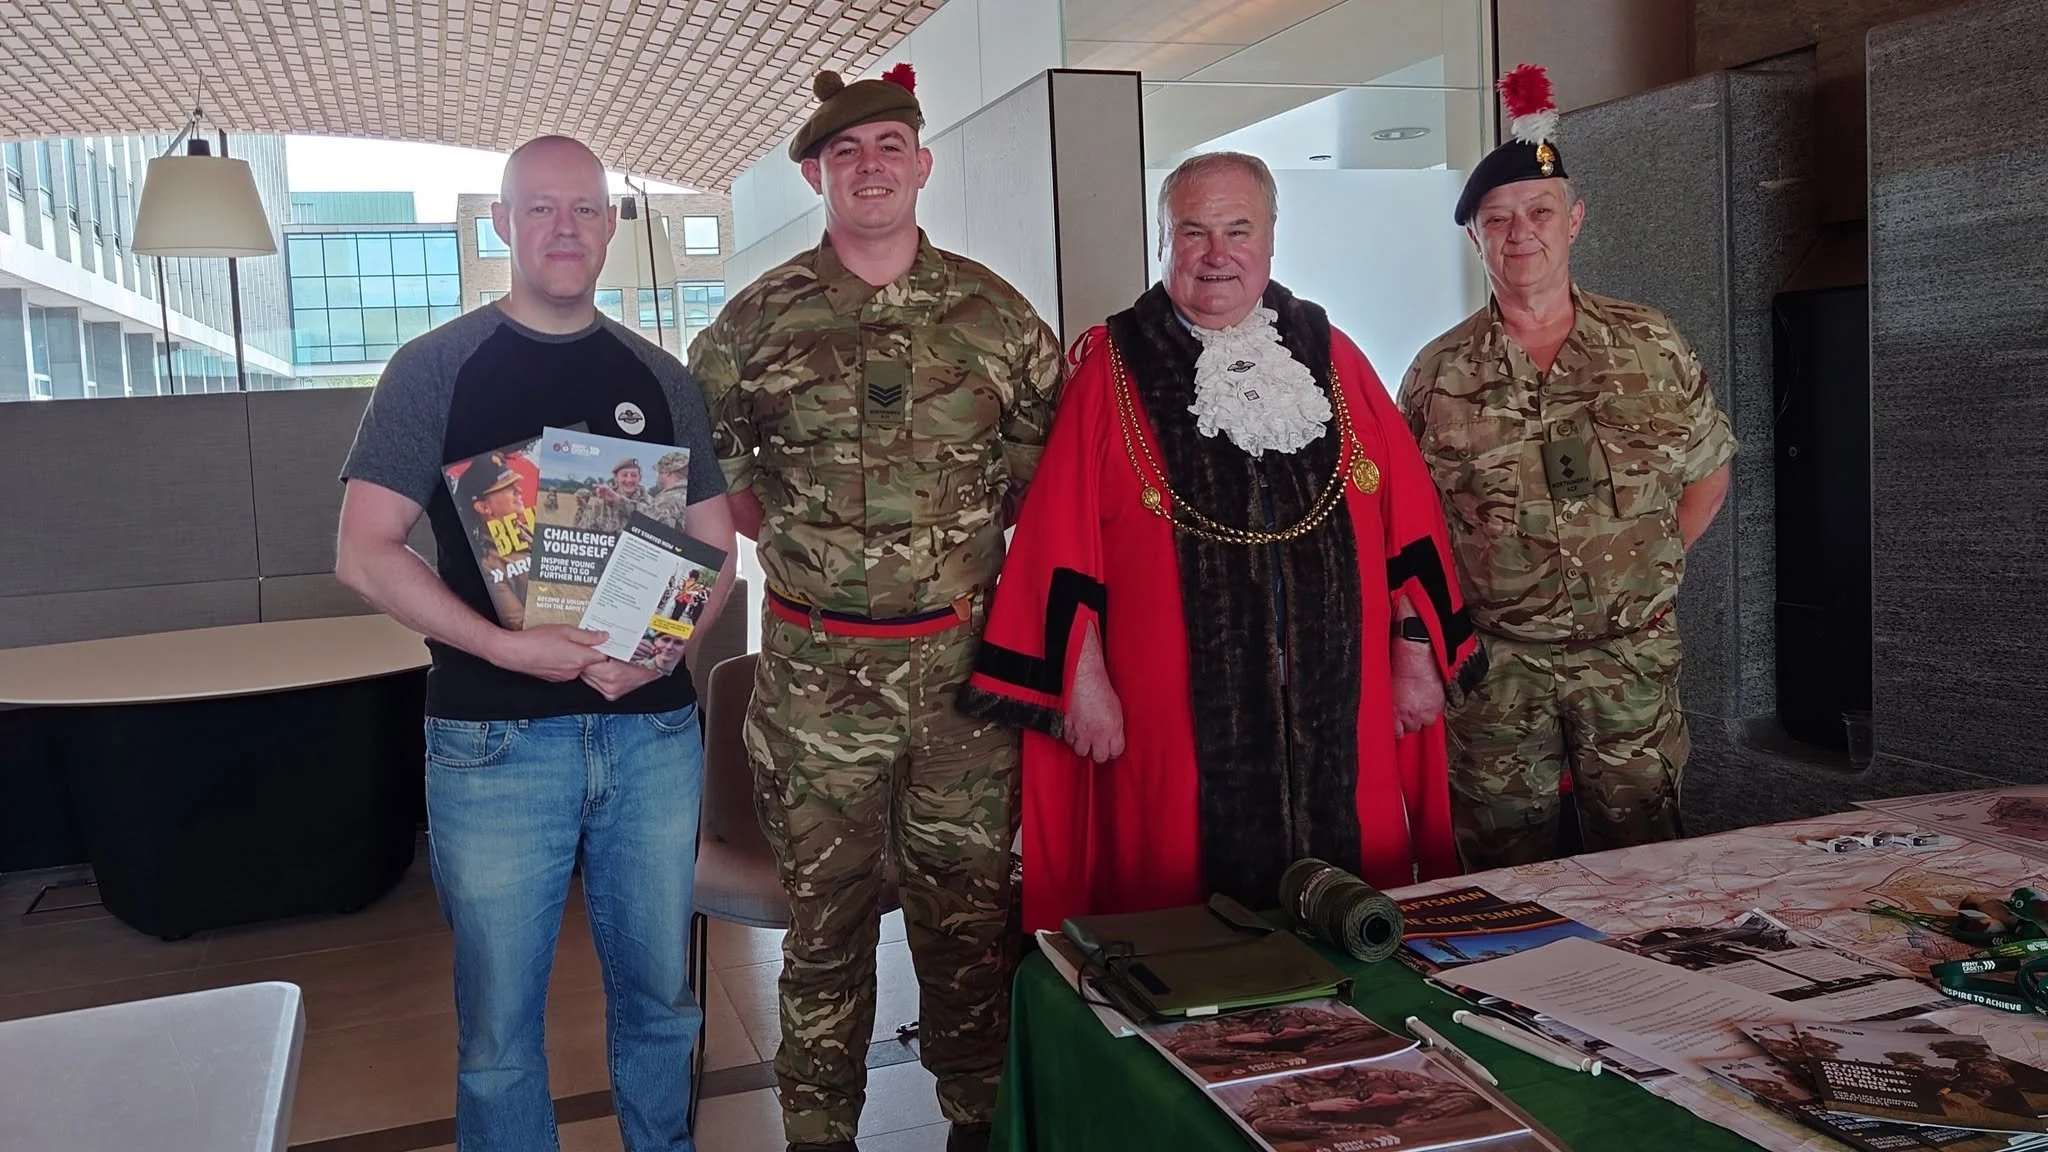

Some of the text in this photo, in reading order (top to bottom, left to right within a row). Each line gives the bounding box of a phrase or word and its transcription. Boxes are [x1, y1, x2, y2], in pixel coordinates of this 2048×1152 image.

[543, 528, 616, 547] CHALLENGE
[631, 526, 641, 535] GET
[641, 530, 662, 545] STARTED
[543, 540, 608, 559] YOURSELF
[540, 564, 590, 576] PEOPLE TO GO
[541, 556, 595, 569] INSPIRE YOUNG
[539, 571, 574, 580] FURTHER
[583, 575, 598, 584] LIFE
[537, 595, 561, 603] BECOME
[1425, 905, 1541, 925] CRAFTSMAN
[1942, 986, 2022, 1011] INSPIRE TO ACHIEVE
[1821, 1060, 1839, 1068] GO
[1826, 1074, 1887, 1088] FUN AND
[1828, 1078, 1912, 1094] FRIENDSHIP
